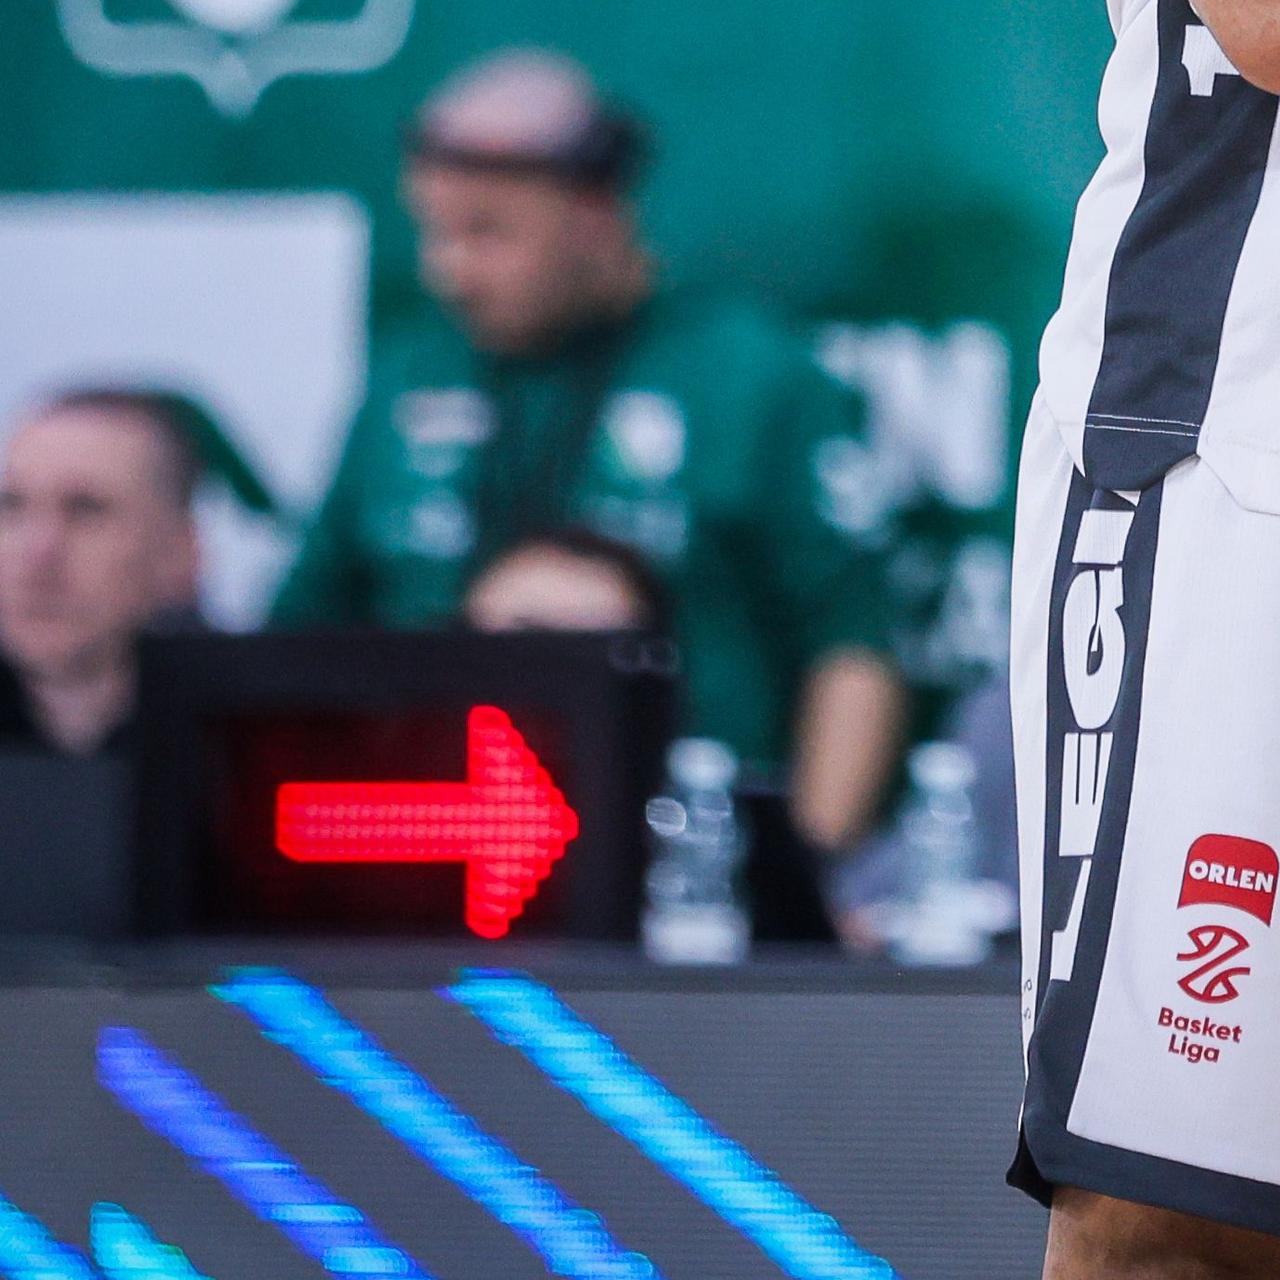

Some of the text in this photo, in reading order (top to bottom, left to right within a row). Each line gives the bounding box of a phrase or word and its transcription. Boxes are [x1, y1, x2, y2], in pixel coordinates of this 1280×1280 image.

[1189, 859, 1273, 893] ORLEN
[1157, 1007, 1242, 1043] Basket
[1168, 1034, 1220, 1063] Liga
